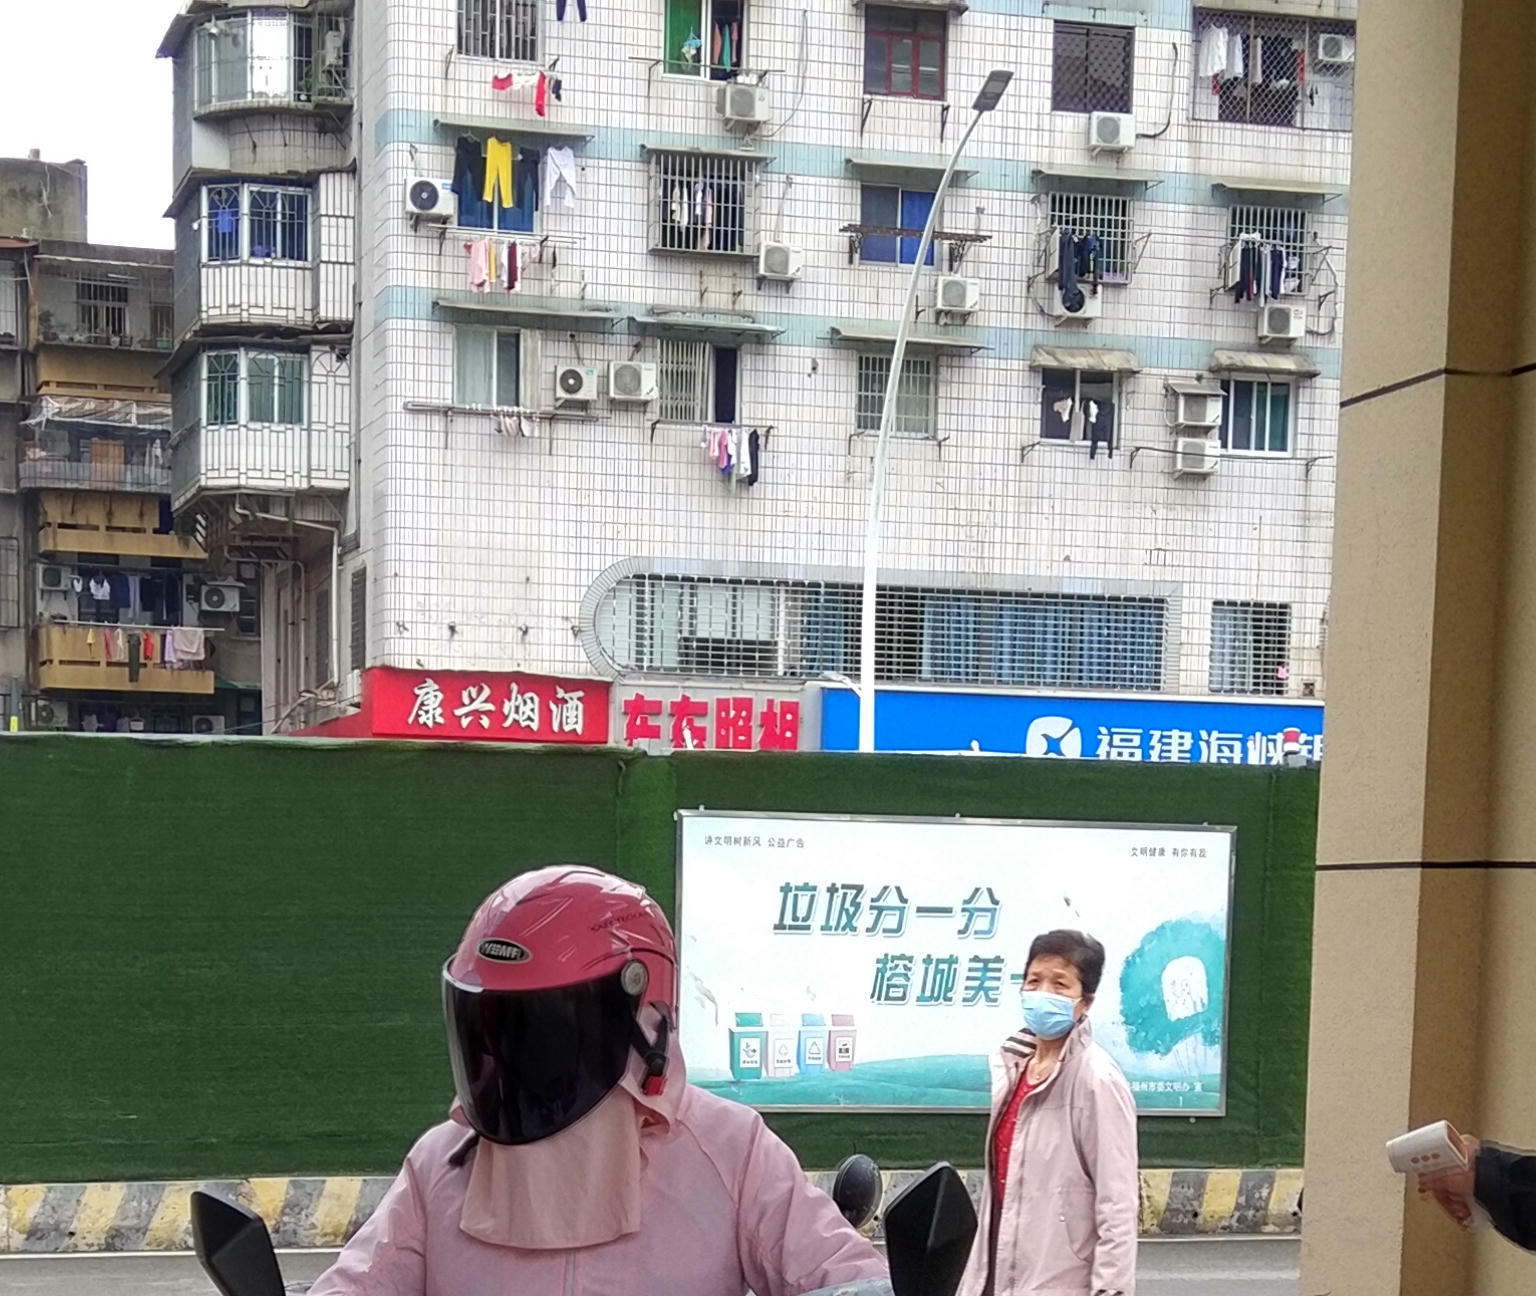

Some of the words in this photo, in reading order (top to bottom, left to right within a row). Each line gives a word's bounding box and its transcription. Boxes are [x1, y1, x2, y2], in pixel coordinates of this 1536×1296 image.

[407, 677, 585, 736] 康兴烟酒
[772, 881, 1002, 937] 垃圾分一分
